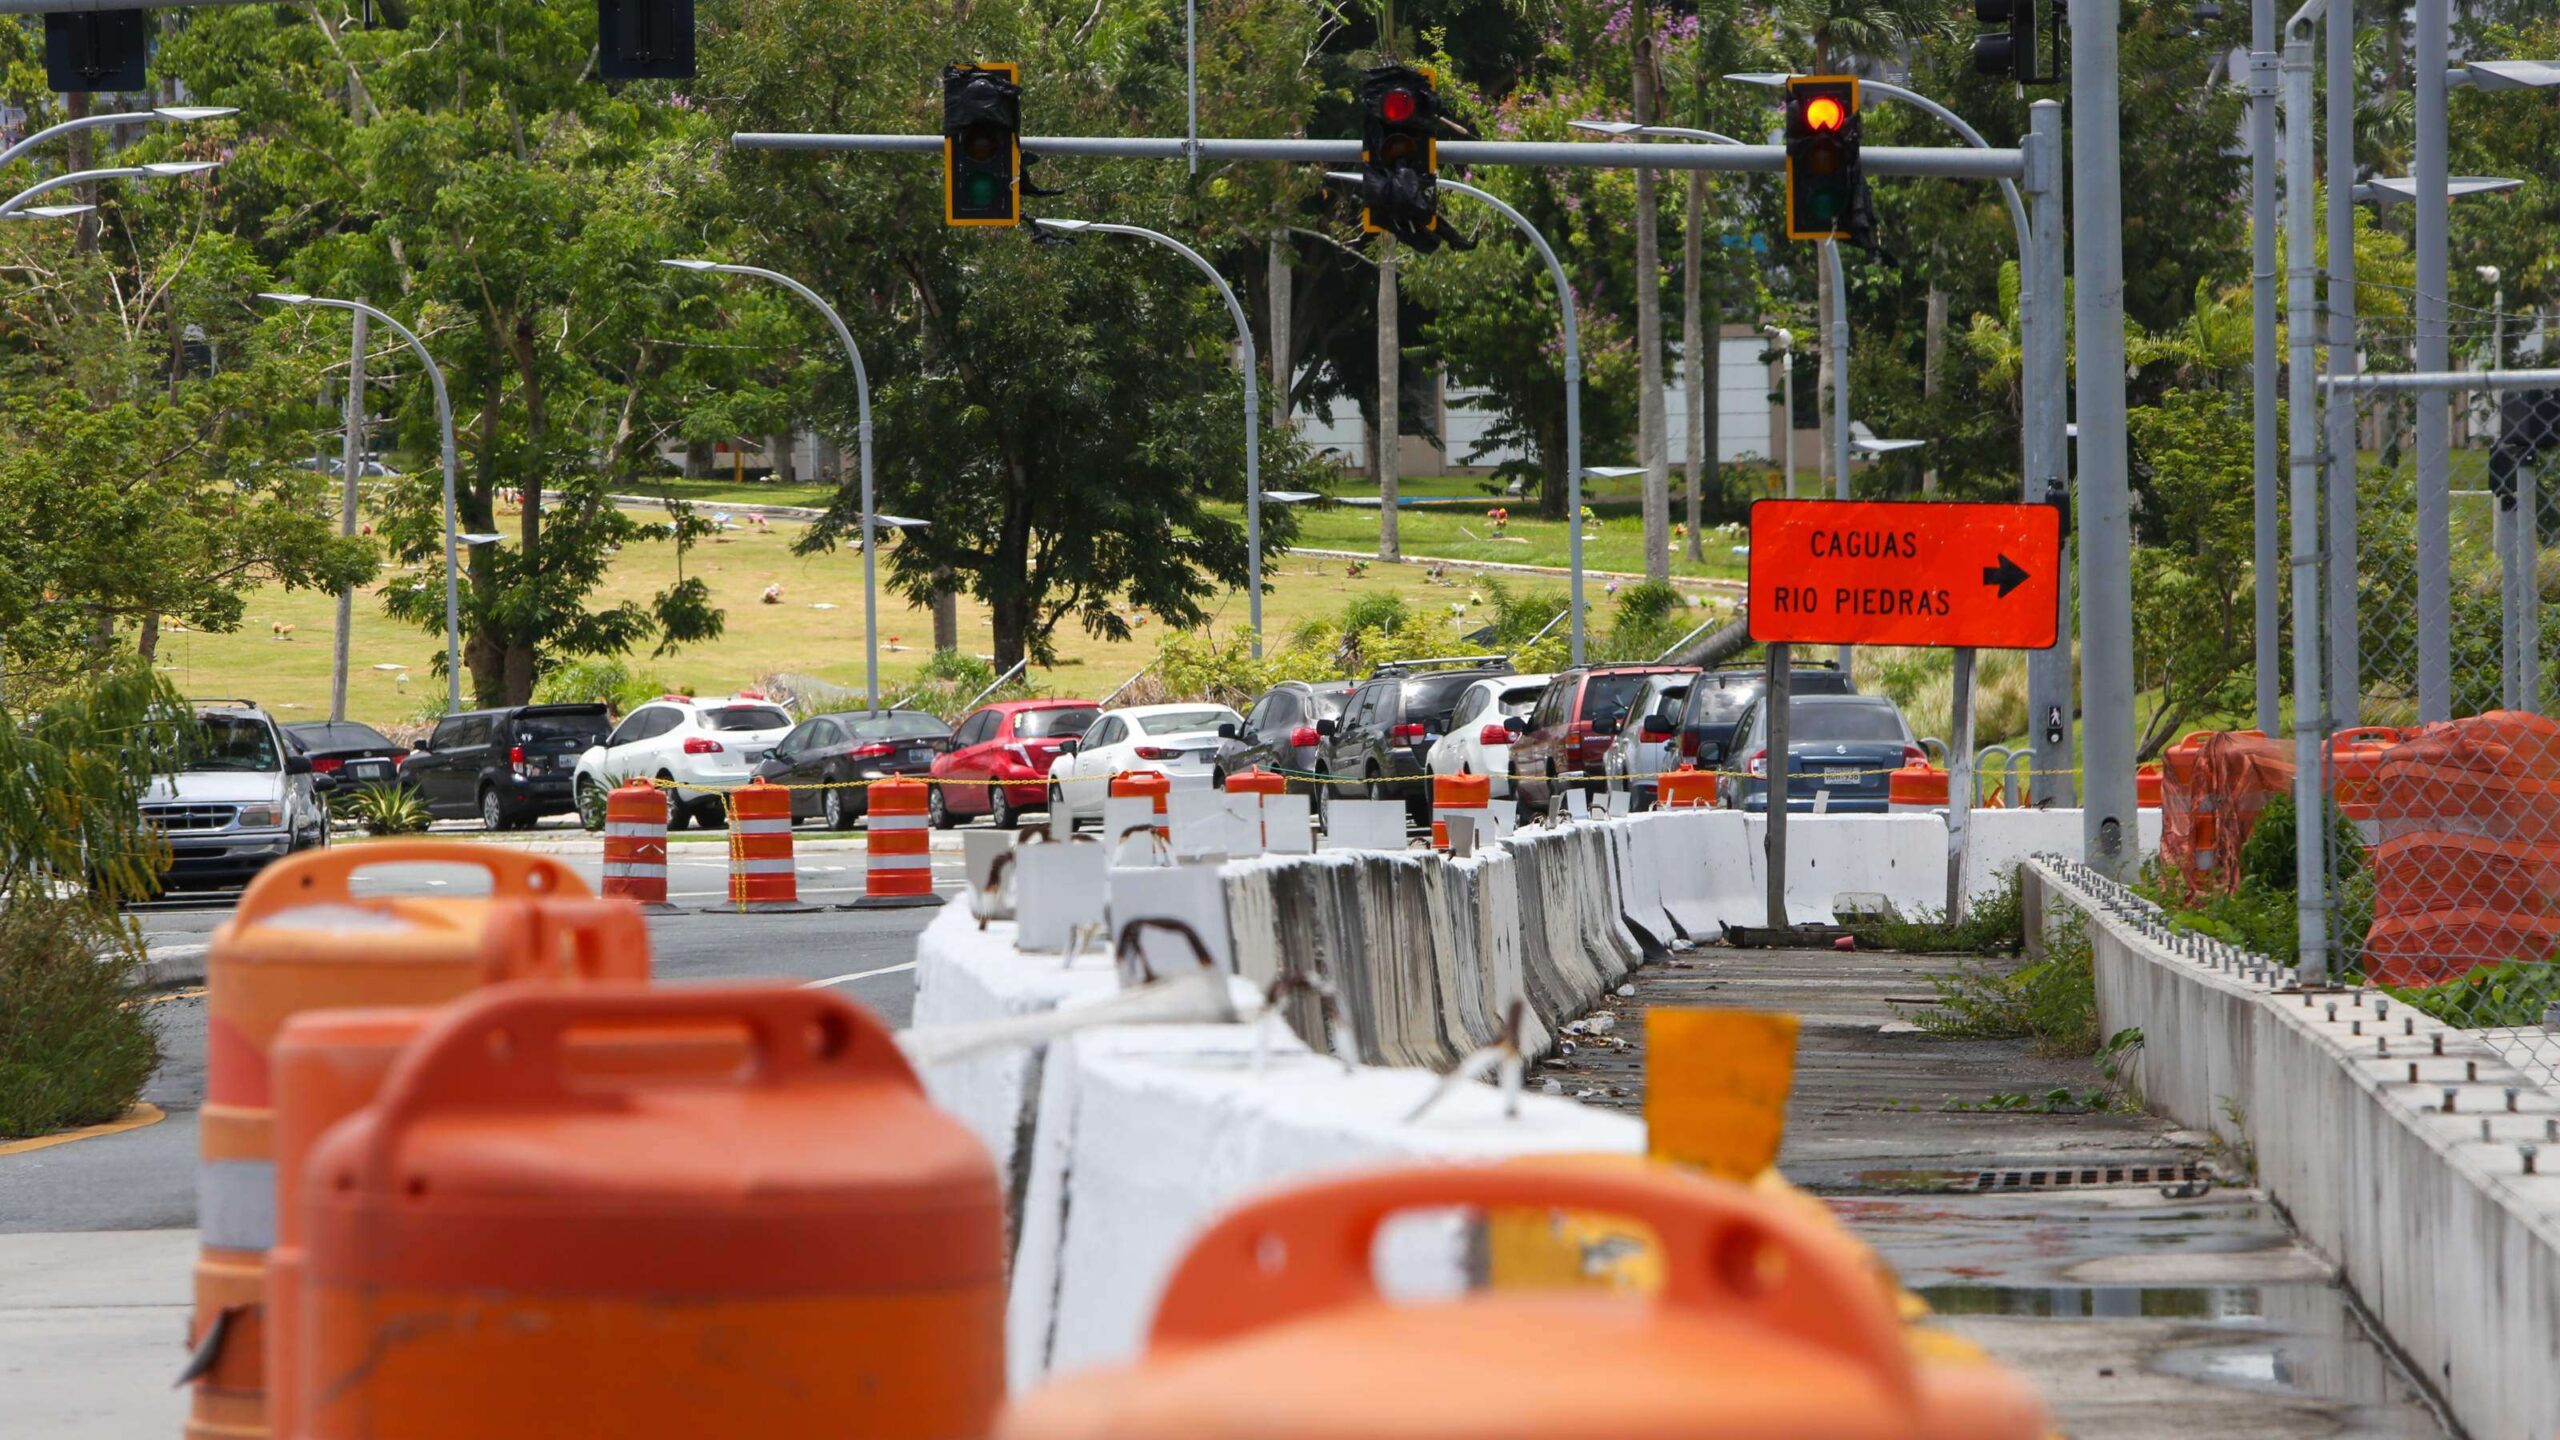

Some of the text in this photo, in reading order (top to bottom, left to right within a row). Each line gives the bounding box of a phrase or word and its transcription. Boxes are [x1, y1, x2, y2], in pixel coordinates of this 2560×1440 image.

[1811, 530, 1917, 559] CAGUAS
[1774, 586, 1950, 616] RIO PIEDRAS
